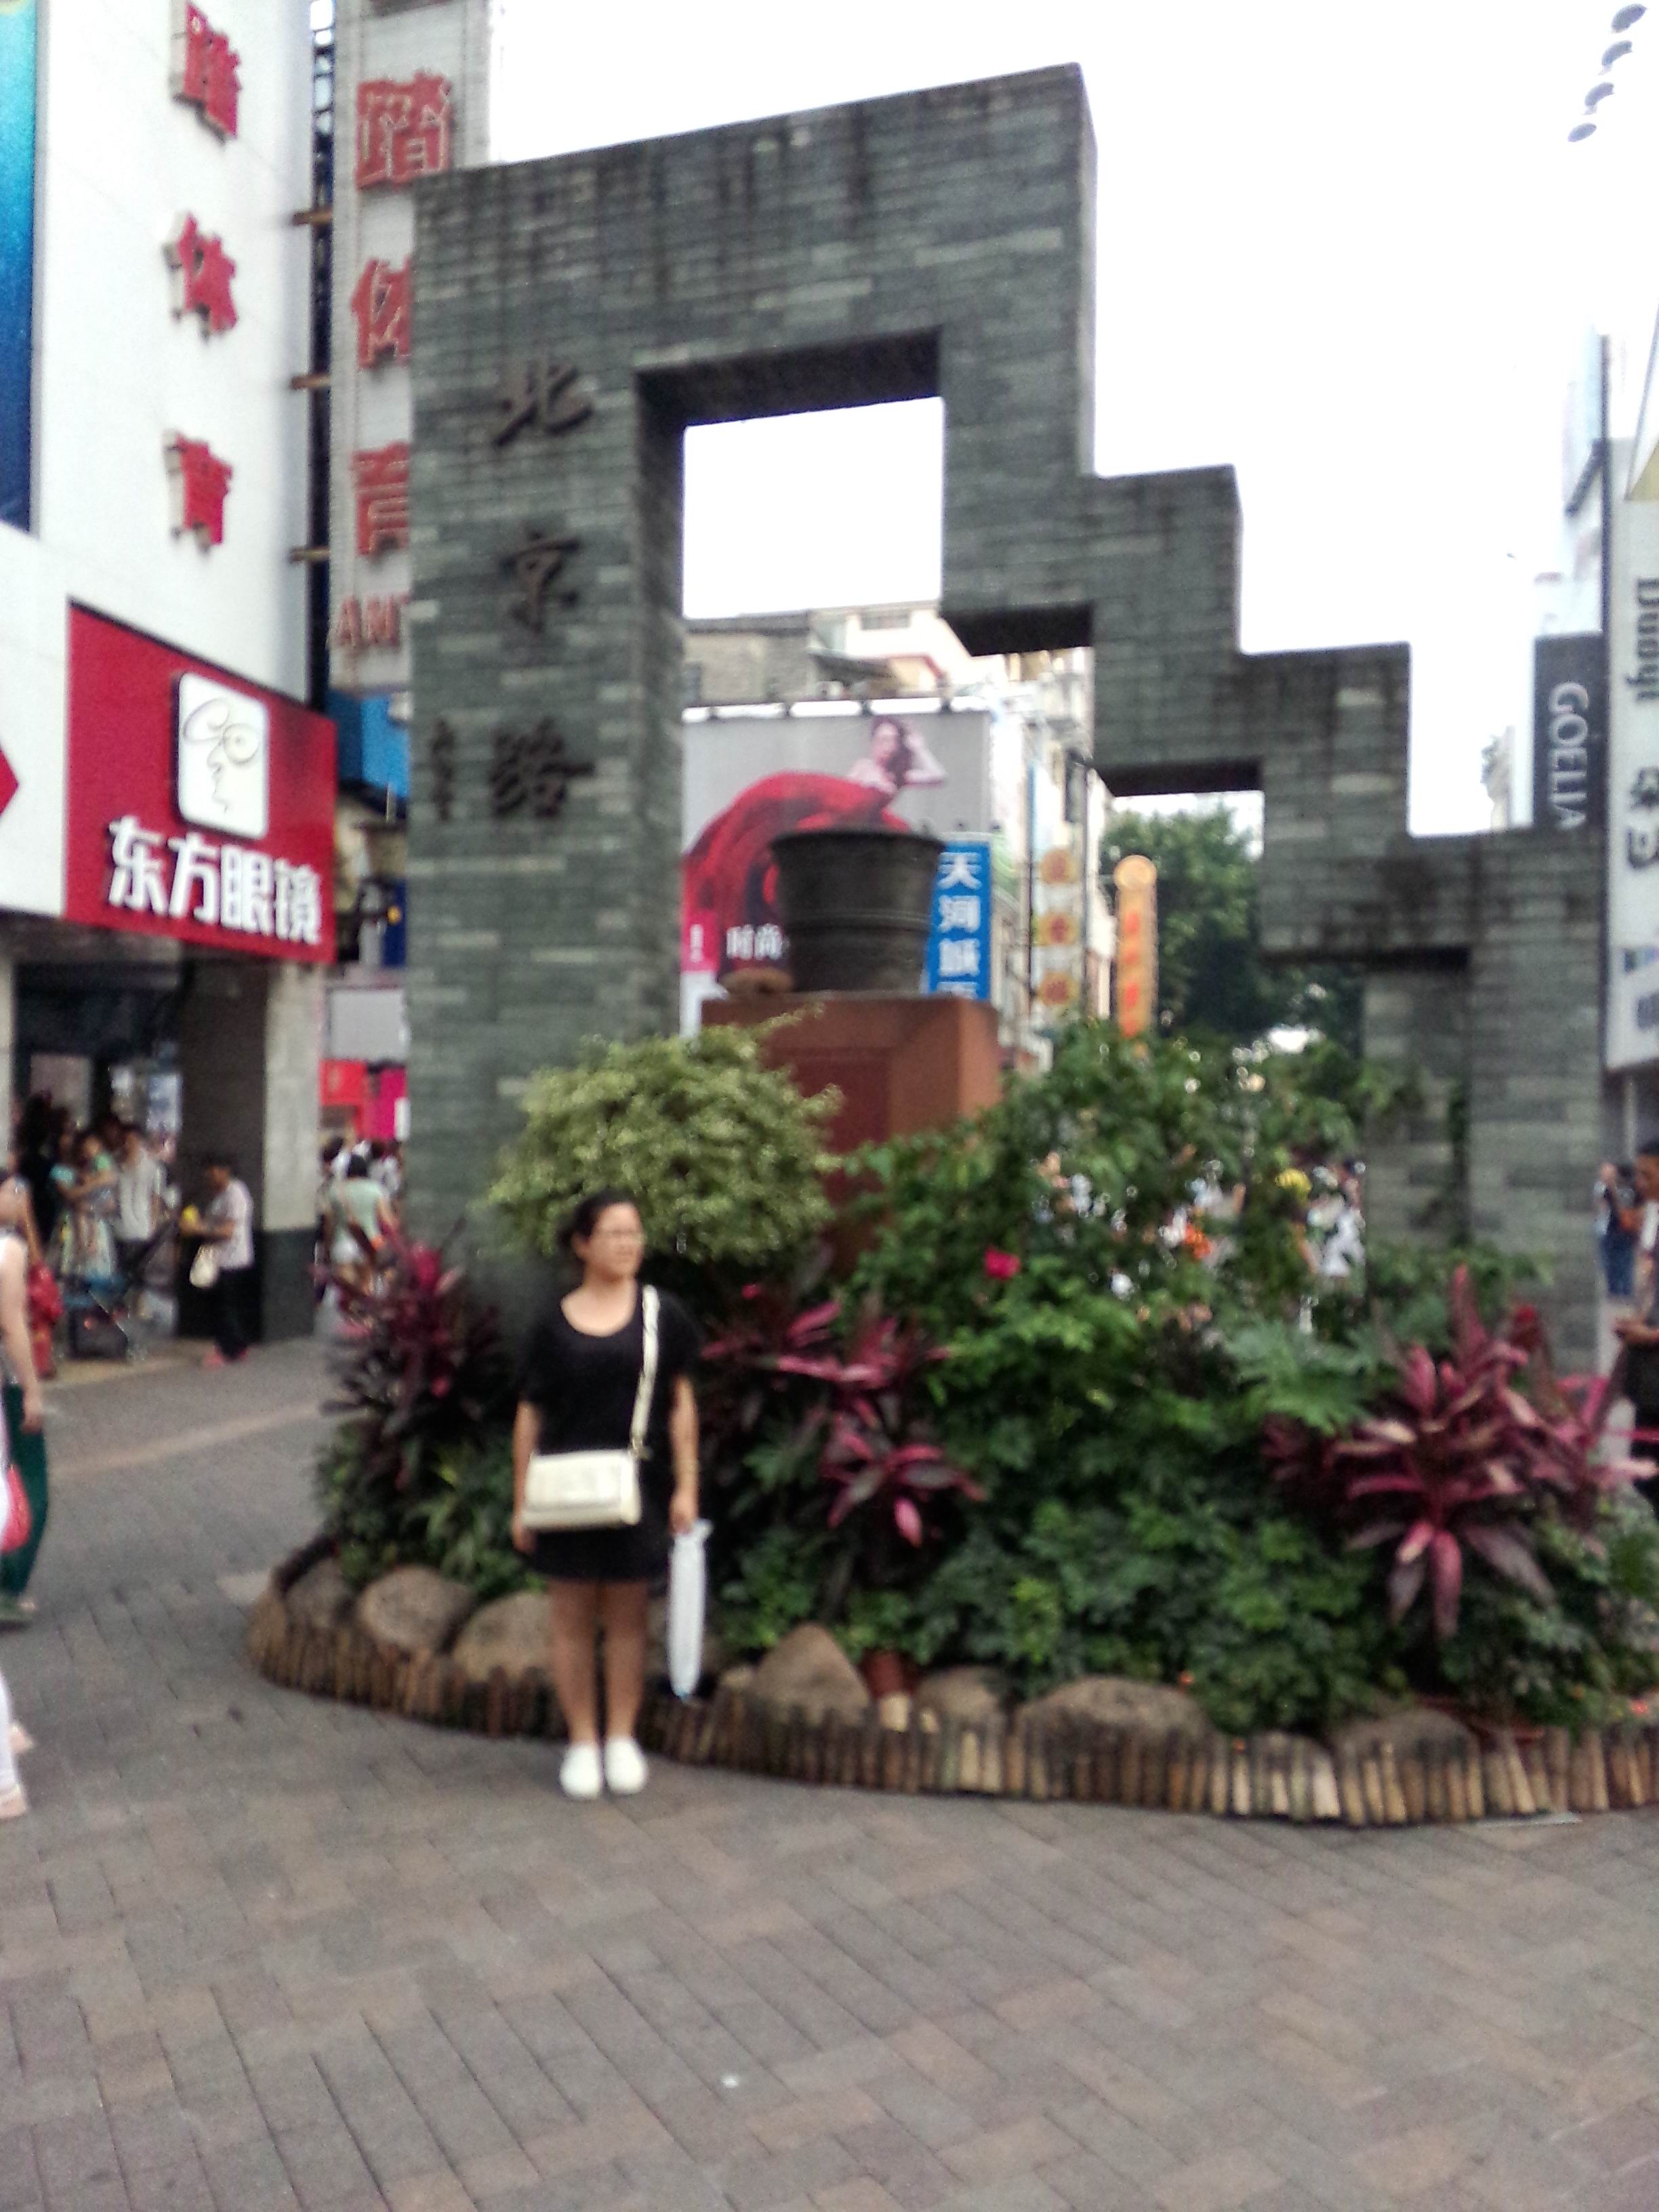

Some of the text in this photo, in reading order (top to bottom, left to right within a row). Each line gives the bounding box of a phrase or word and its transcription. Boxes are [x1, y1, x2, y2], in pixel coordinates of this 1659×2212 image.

[1548, 680, 1590, 831] GOELIA
[107, 815, 322, 945] 东方眼镜
[726, 923, 787, 960] 时尚
